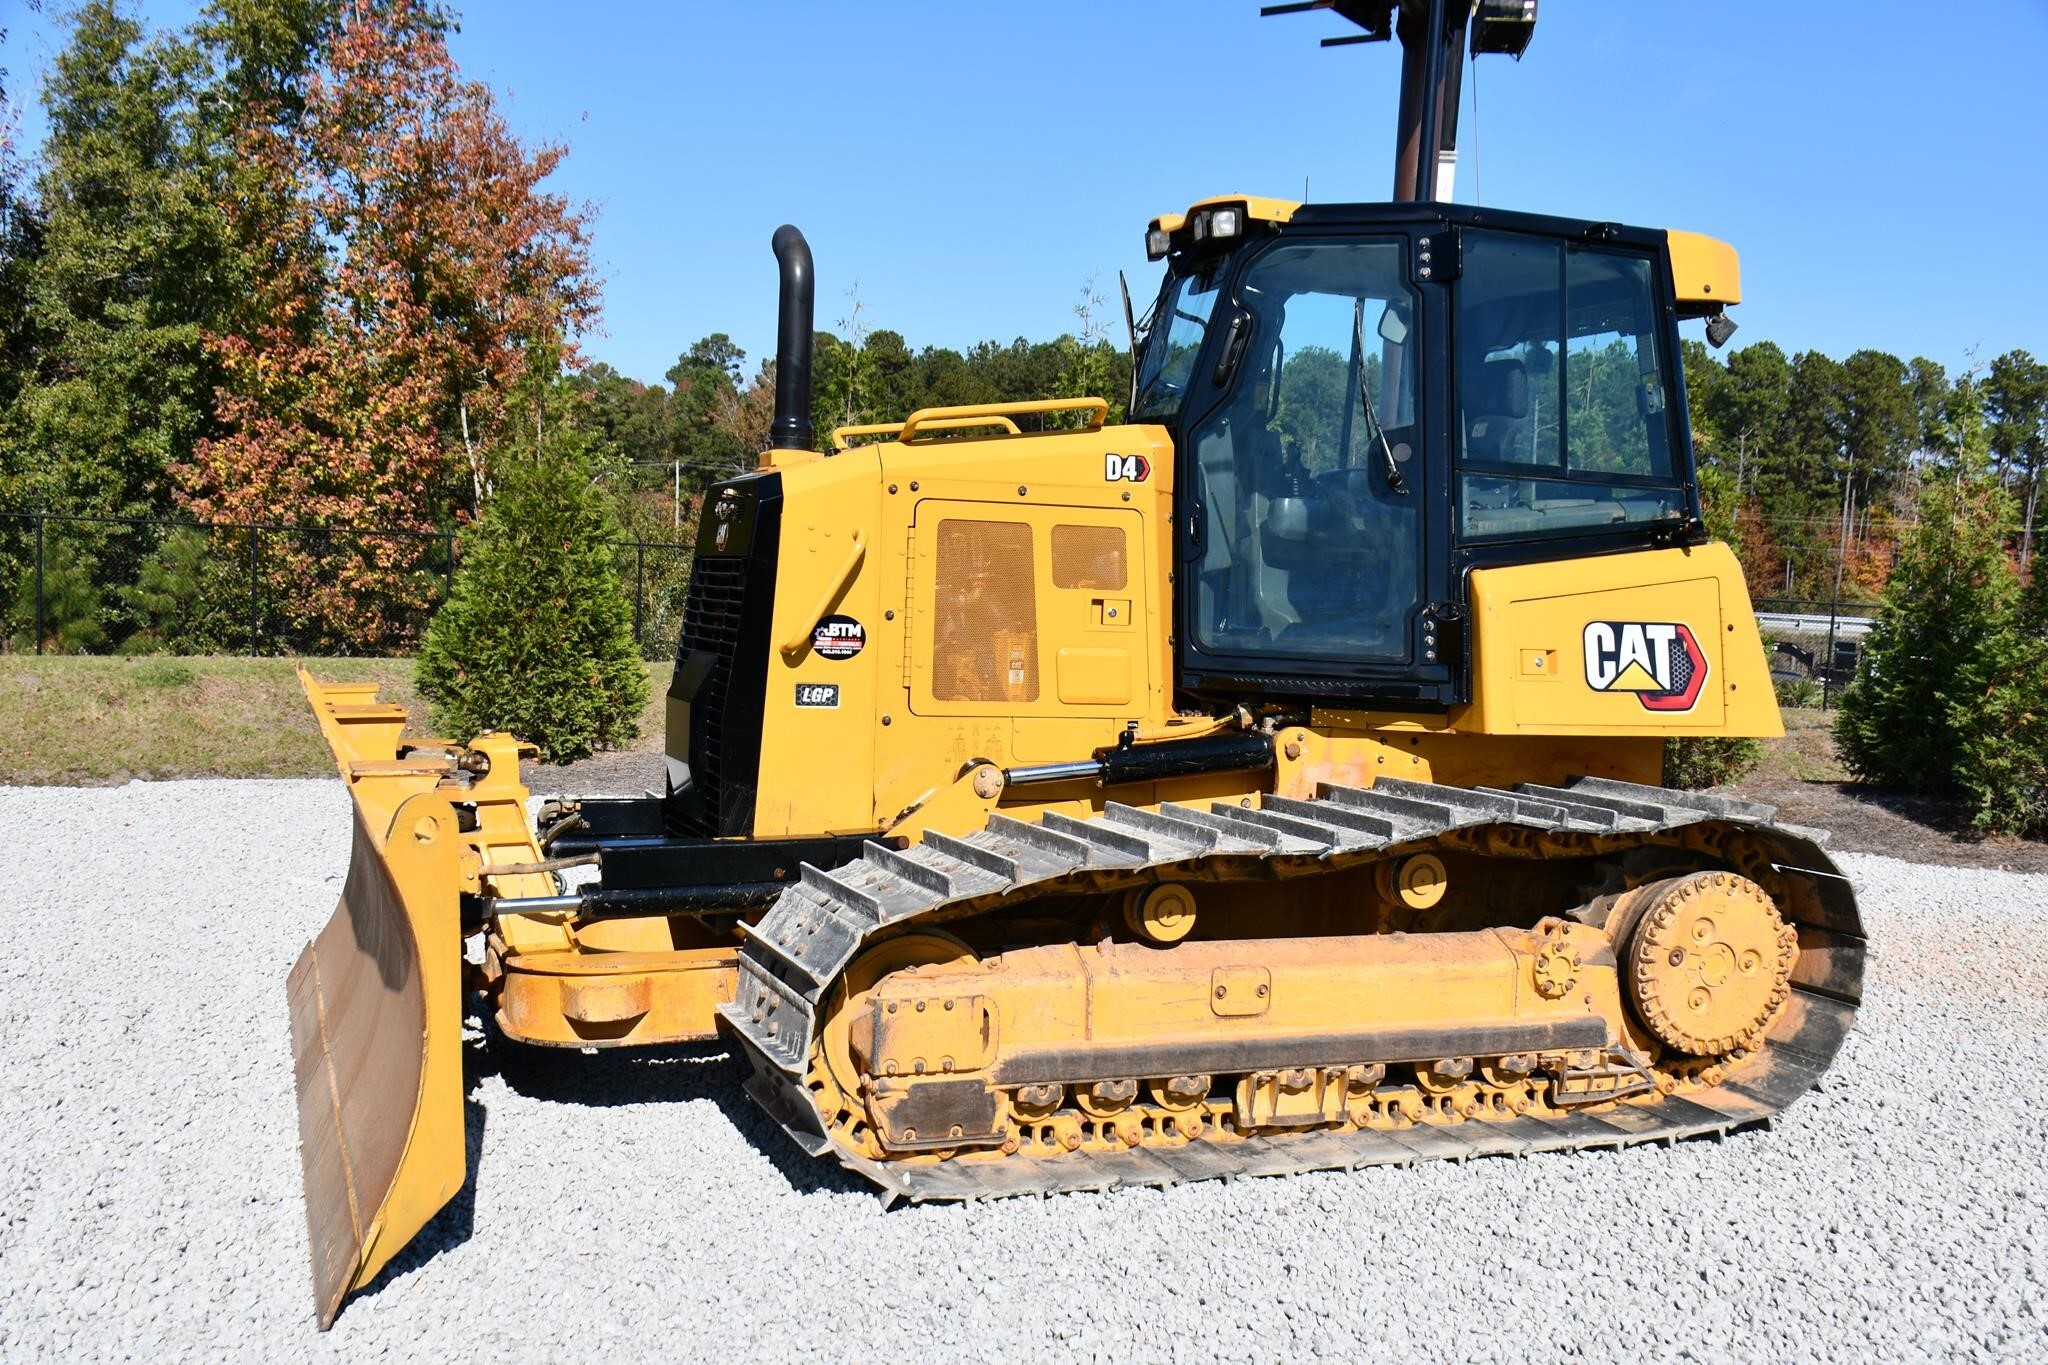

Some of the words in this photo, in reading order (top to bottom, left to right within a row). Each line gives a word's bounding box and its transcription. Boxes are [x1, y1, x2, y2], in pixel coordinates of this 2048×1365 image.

[1106, 454, 1137, 481] D4
[829, 623, 861, 637] BTM
[1584, 622, 1676, 690] CAT
[802, 687, 834, 703] LGP
